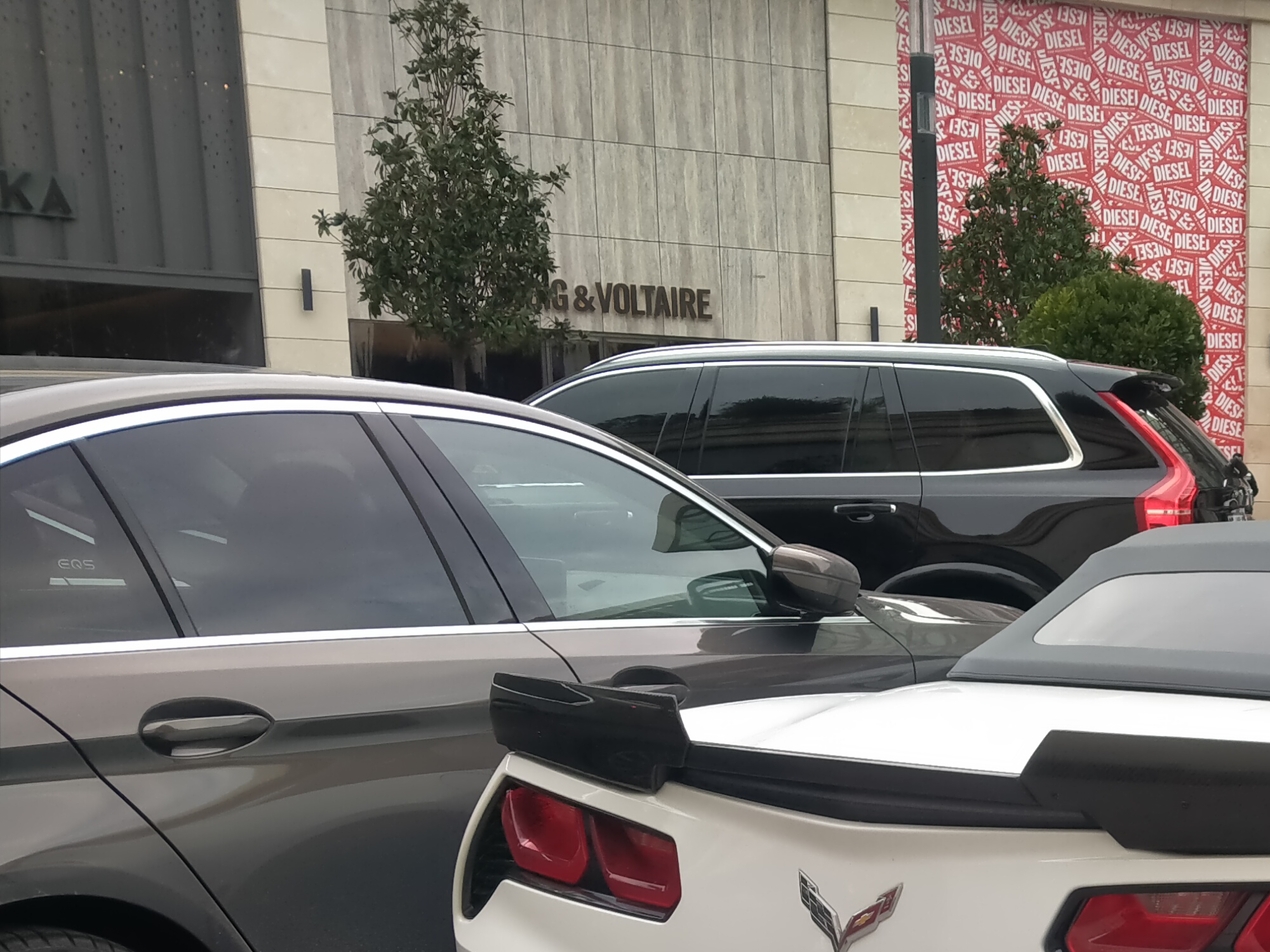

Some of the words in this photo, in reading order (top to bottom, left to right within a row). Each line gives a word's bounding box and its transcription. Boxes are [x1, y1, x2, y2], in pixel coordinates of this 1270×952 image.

[1044, 28, 1086, 50] DIESEL
[1152, 41, 1193, 62] DIESEL
[936, 141, 978, 163] DIESEL
[1045, 151, 1087, 173] DIESEL
[1153, 161, 1193, 183] DIESEL
[594, 282, 713, 320] VOLTAIRE
[57, 558, 96, 570] EQS
